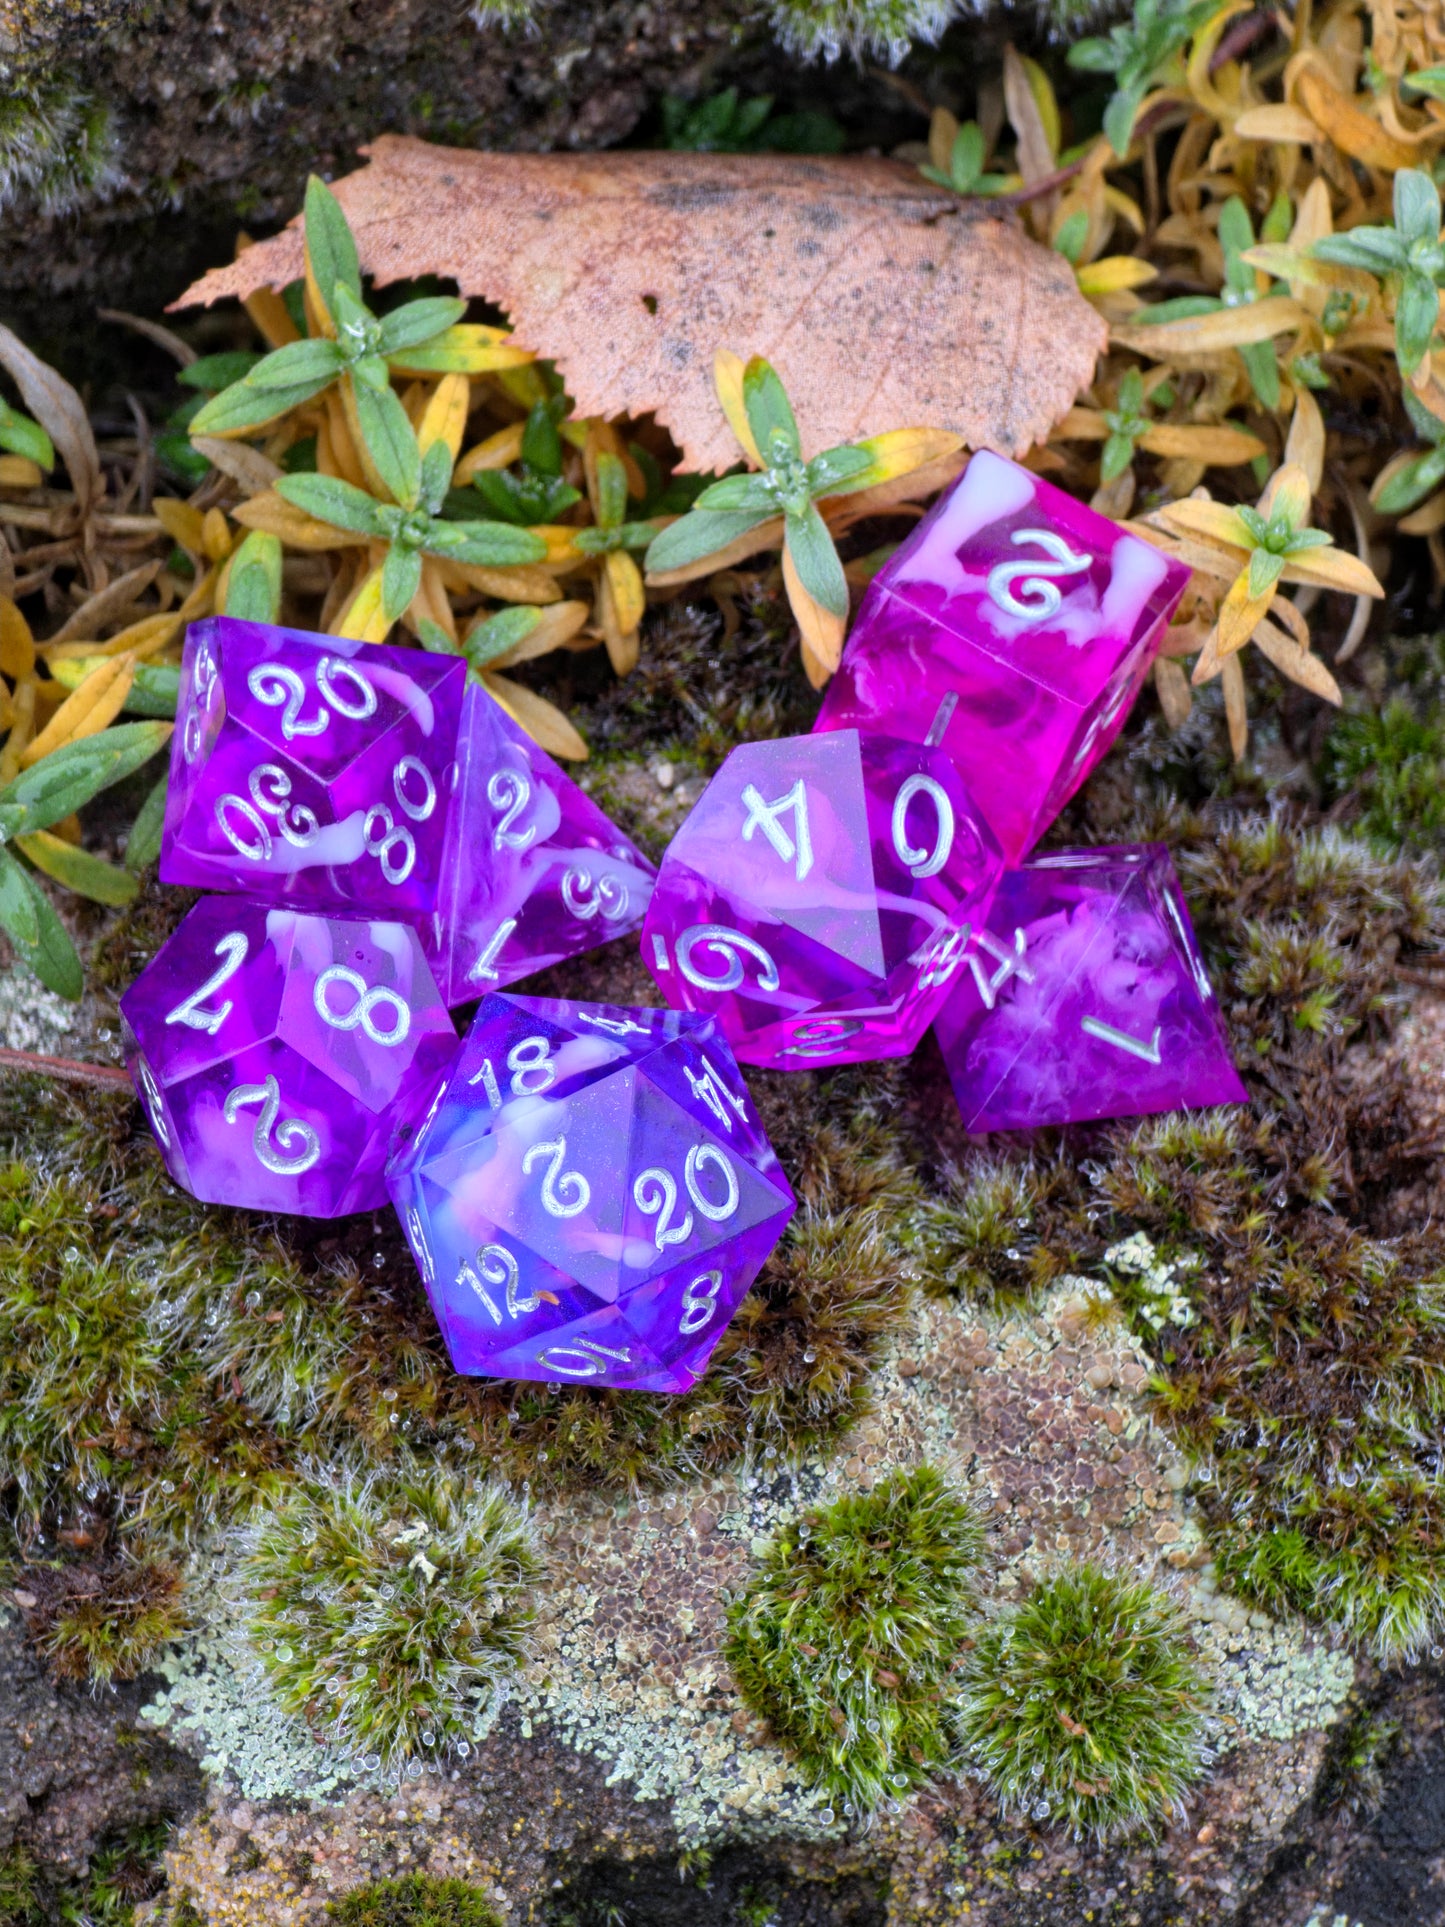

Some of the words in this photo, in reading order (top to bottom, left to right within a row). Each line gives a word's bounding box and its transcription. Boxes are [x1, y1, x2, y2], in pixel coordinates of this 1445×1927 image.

[987, 529, 1093, 621] 2
[248, 656, 377, 740] 20
[214, 764, 320, 861] 30
[363, 755, 436, 885] 80
[487, 768, 536, 850] 2
[741, 779, 813, 882] 4
[892, 773, 954, 878] 0
[561, 866, 629, 920] 3
[314, 964, 410, 1046] 8
[579, 1012, 652, 1035] 4
[468, 1036, 557, 1110] 18
[683, 1055, 749, 1132] 14
[224, 1074, 320, 1174] 2
[522, 1133, 590, 1218] 2
[633, 1143, 740, 1252] 20
[455, 1243, 541, 1325] 12
[679, 1270, 723, 1334] 8
[535, 1337, 632, 1377] 10
